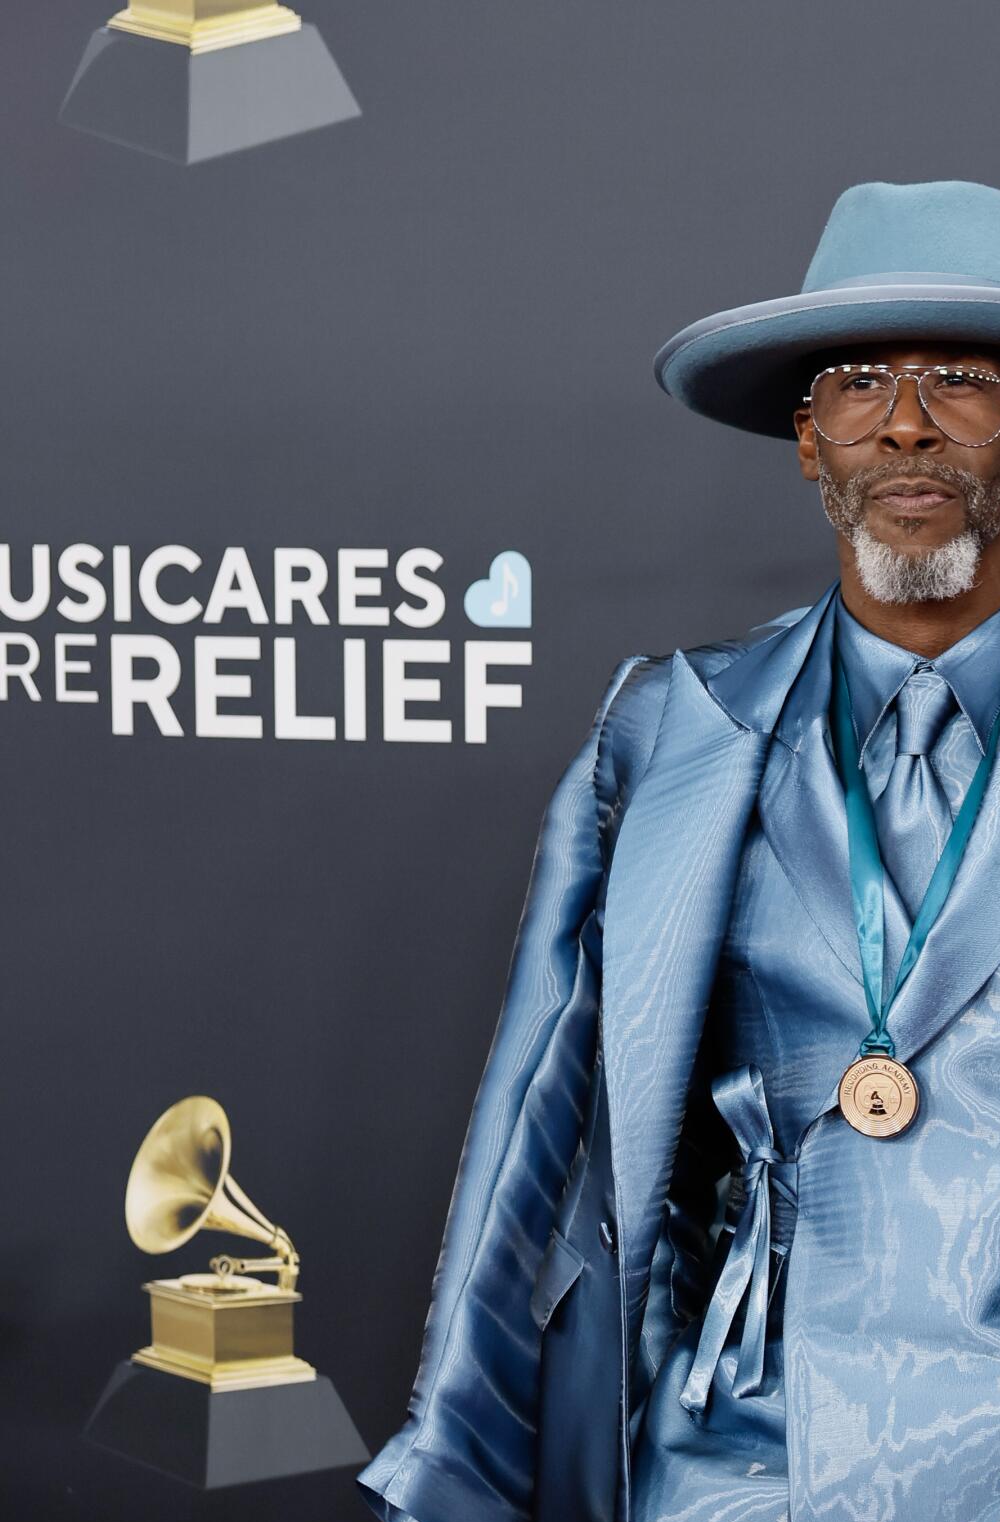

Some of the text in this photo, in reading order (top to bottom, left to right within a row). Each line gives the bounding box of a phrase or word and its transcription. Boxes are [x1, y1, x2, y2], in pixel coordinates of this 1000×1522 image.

[0, 543, 446, 628] USICARES
[111, 633, 533, 744] RELIEF
[844, 1062, 879, 1097] RECORDING
[881, 1063, 913, 1097] ACADEMY
